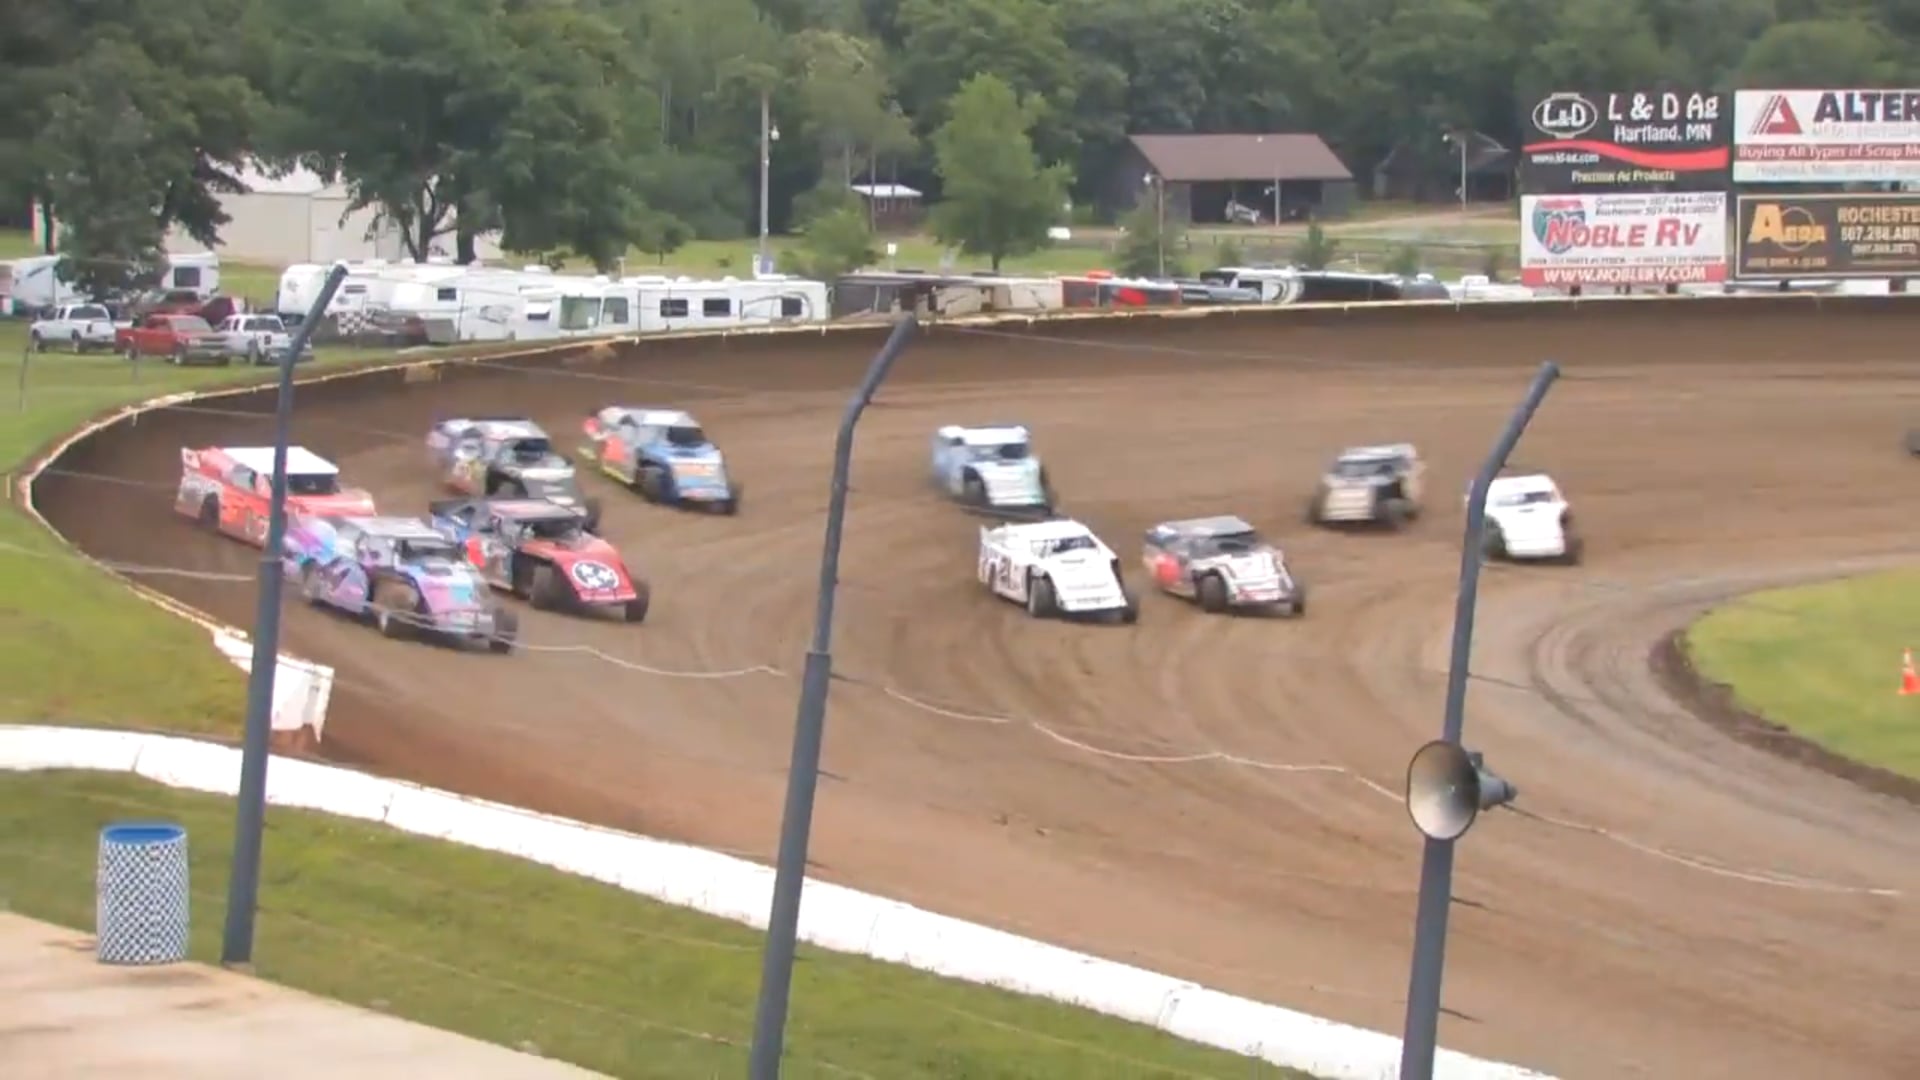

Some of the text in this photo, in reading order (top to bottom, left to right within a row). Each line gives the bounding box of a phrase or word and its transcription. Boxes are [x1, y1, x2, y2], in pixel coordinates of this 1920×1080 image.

[1541, 102, 1587, 127] L&D
[1607, 92, 1719, 120] L & D Ag
[1685, 123, 1713, 142] MN
[1738, 144, 1785, 159] Buying
[1865, 145, 1902, 160] Scrap
[1543, 265, 1707, 284] WWW.NOBLERV.COM
